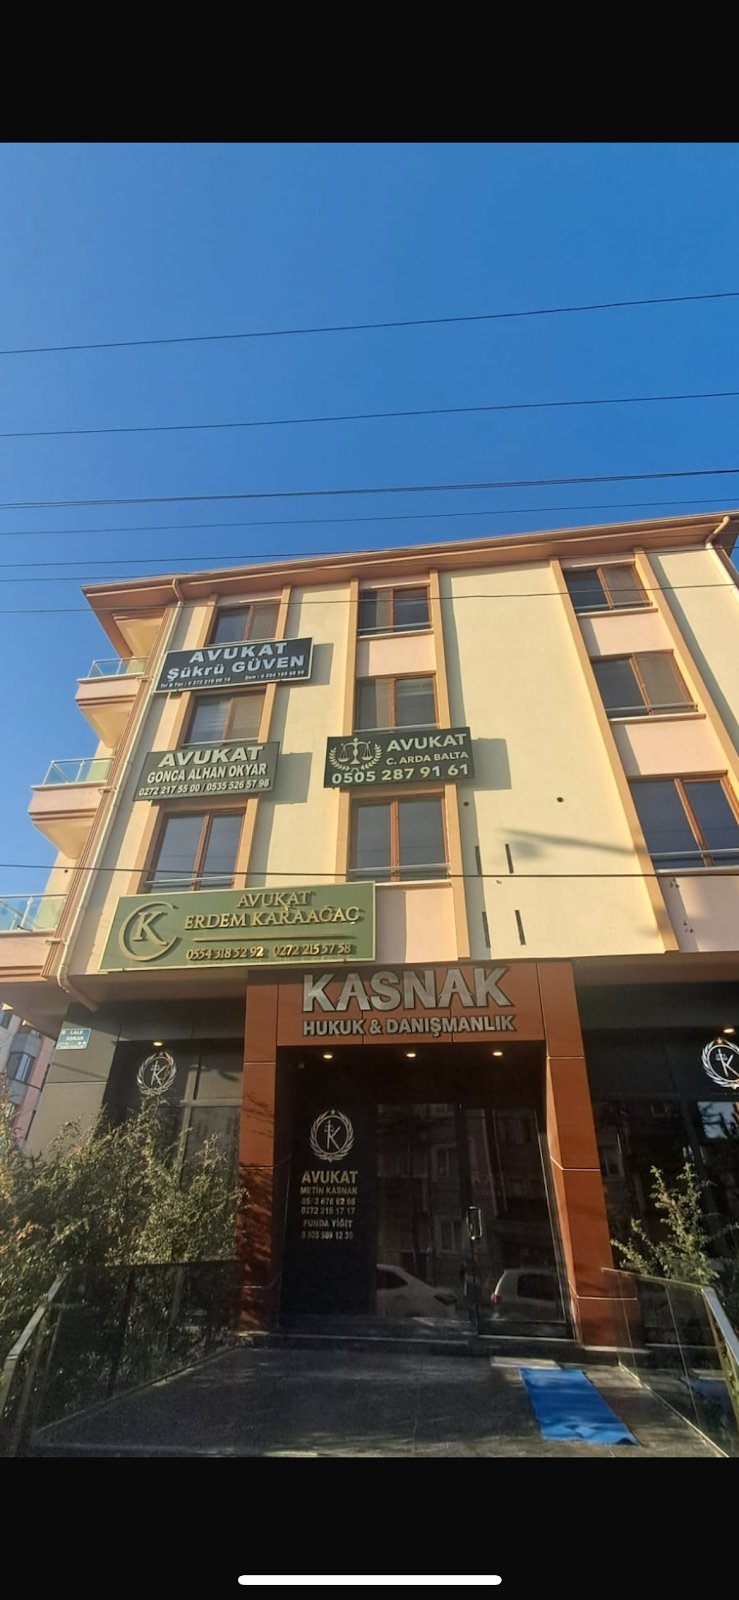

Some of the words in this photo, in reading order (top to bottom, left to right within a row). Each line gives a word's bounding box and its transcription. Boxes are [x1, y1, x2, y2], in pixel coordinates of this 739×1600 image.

[189, 642, 287, 663] AVUKAT
[167, 664, 224, 682] Şükrü
[232, 655, 304, 673] GÜVEN
[386, 734, 466, 752] AVUKAT
[158, 746, 263, 767] AVUKAT
[399, 755, 432, 764] ARDA
[434, 752, 468, 761] BALTA
[147, 768, 185, 784] GONCA
[188, 766, 226, 781] ALHAN
[229, 763, 266, 777] OKYAR
[332, 771, 376, 784] 0505
[382, 768, 414, 780] 287
[420, 766, 440, 778] 91
[448, 764, 468, 776] 61
[139, 787, 159, 796] 0272
[161, 785, 176, 795] 217
[177, 784, 188, 793] 55
[189, 784, 200, 792] 00
[201, 783, 205, 792] /
[206, 781, 227, 791] 0535
[229, 780, 244, 789] 526
[246, 779, 257, 788] 57
[238, 891, 311, 909] AVUKAT
[184, 911, 246, 930] ERDEM
[252, 905, 360, 926] KARAAĞAÇ
[186, 949, 212, 960] 0554
[215, 948, 231, 959] 318
[233, 947, 247, 958] 52
[250, 946, 264, 957] 92
[274, 945, 299, 956] 0272
[302, 944, 320, 955] 215
[322, 943, 334, 954] 57
[338, 943, 351, 954] 58
[303, 967, 513, 1012] KASNAK
[303, 1019, 364, 1036] HUKUK
[369, 1019, 382, 1034] &
[386, 1015, 516, 1037] DANIŞMANLIK
[301, 1170, 358, 1184] AVUKAT
[300, 1186, 324, 1194] METİN
